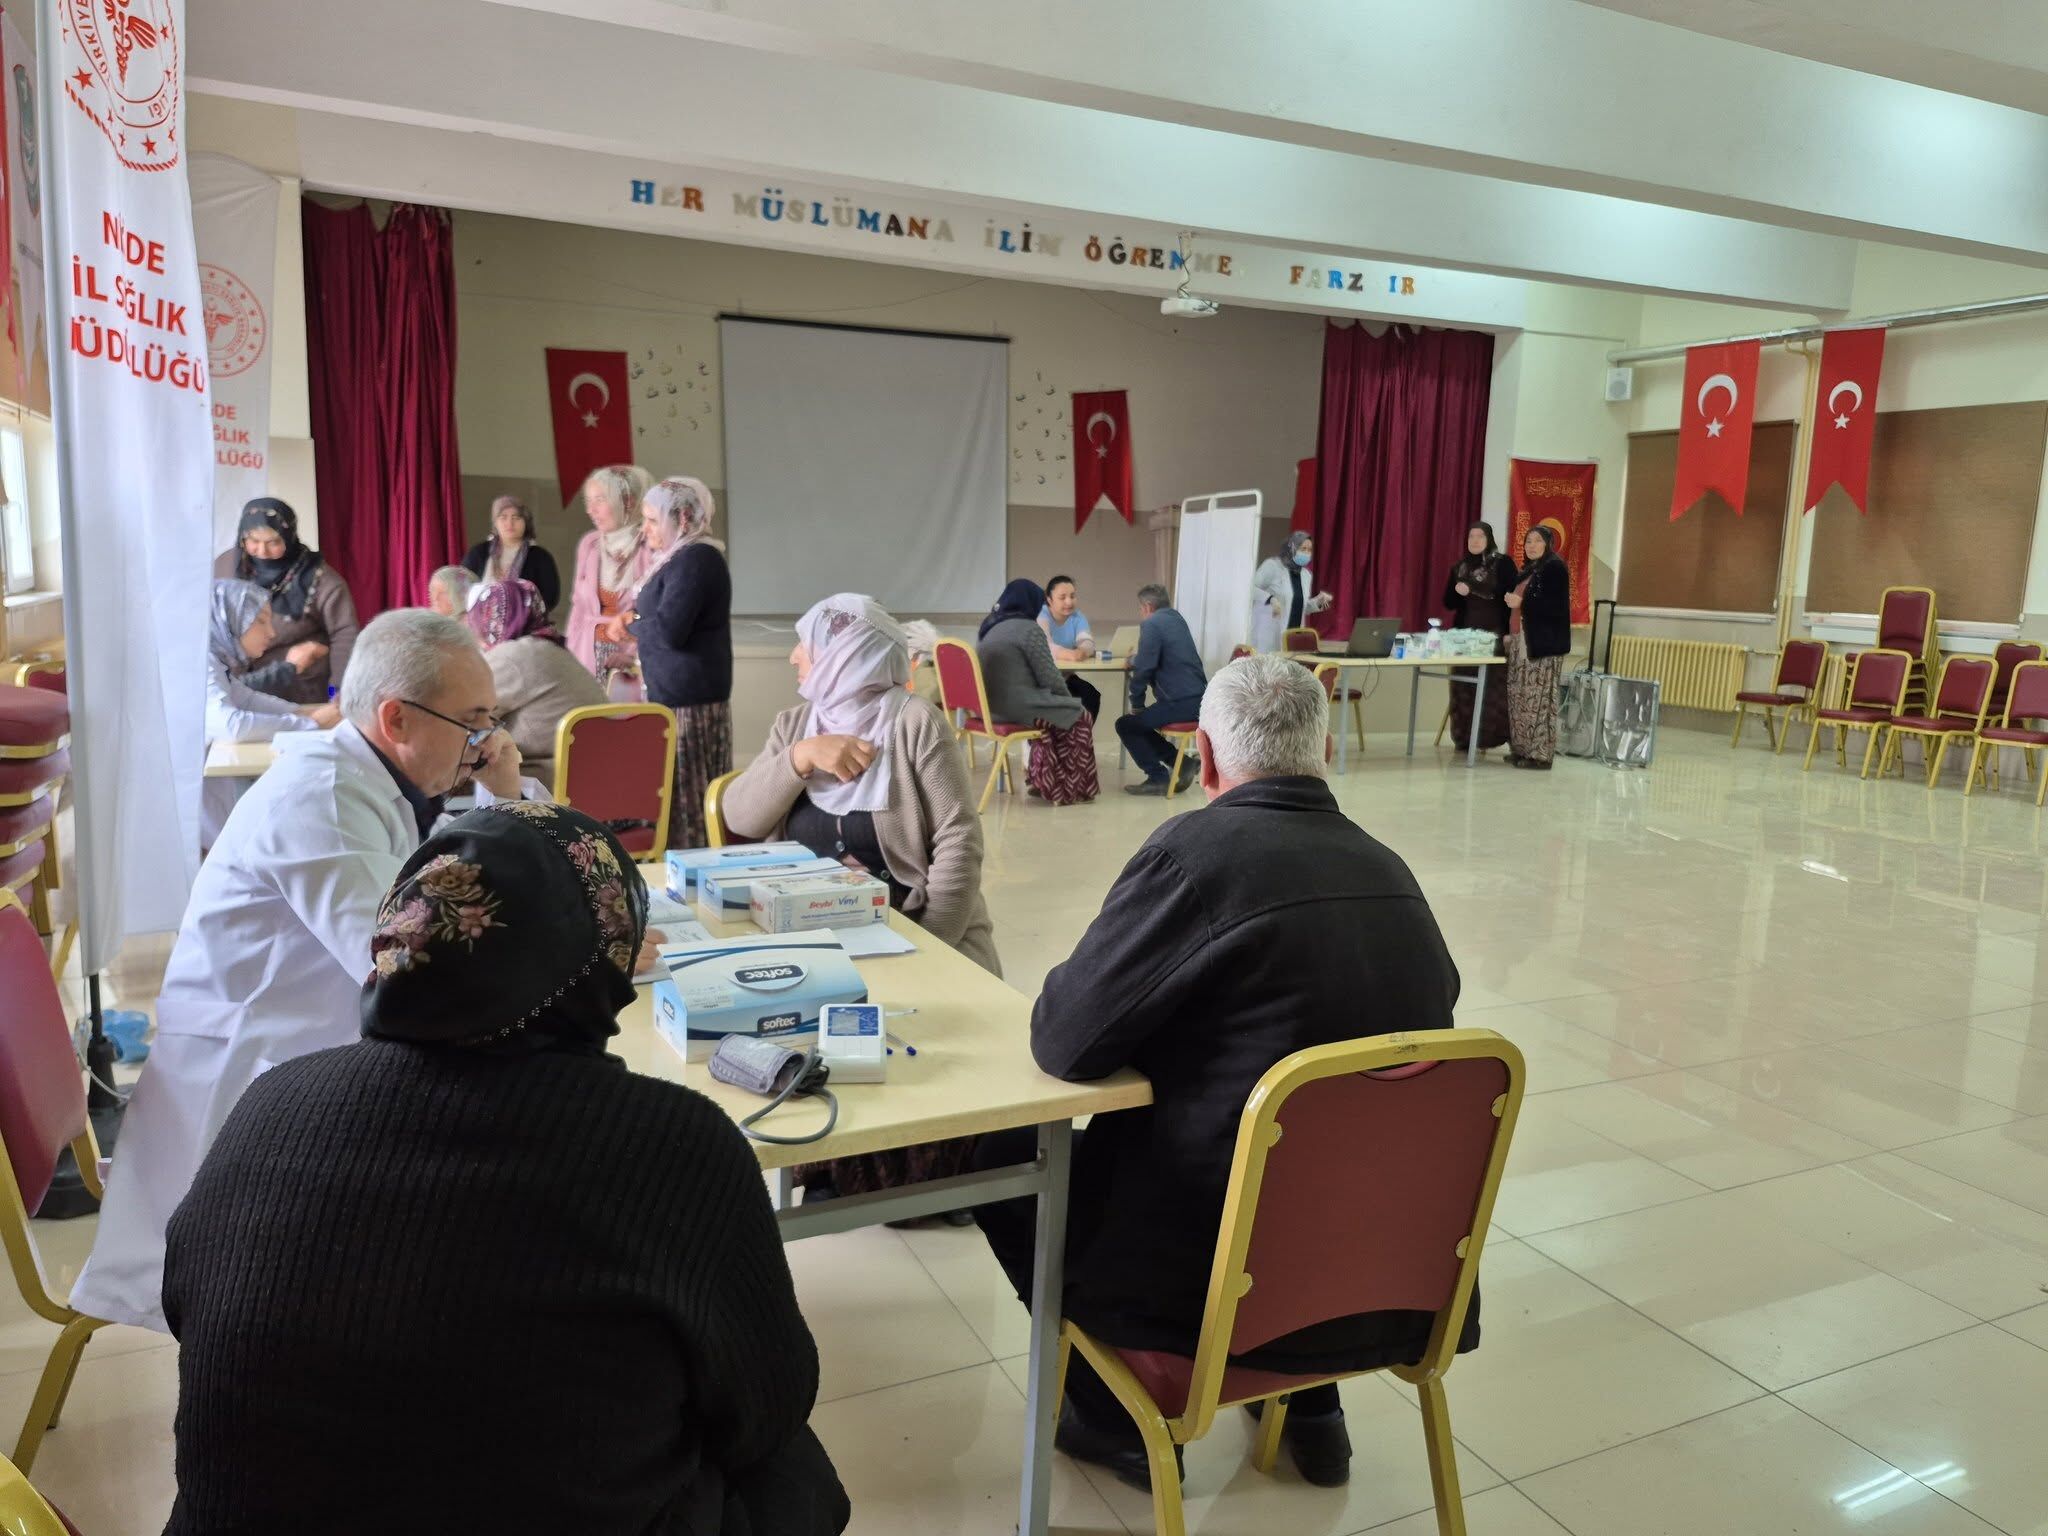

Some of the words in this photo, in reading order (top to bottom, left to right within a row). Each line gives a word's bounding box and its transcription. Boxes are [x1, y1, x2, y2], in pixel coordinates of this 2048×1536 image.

[630, 179, 705, 213] HER
[732, 187, 955, 243] MÜSLÜMANA
[1289, 265, 1364, 292] FARZ
[72, 254, 108, 303] İL
[838, 895, 859, 905] Vinyl
[744, 966, 793, 980] softec
[762, 1015, 796, 1031] softec
